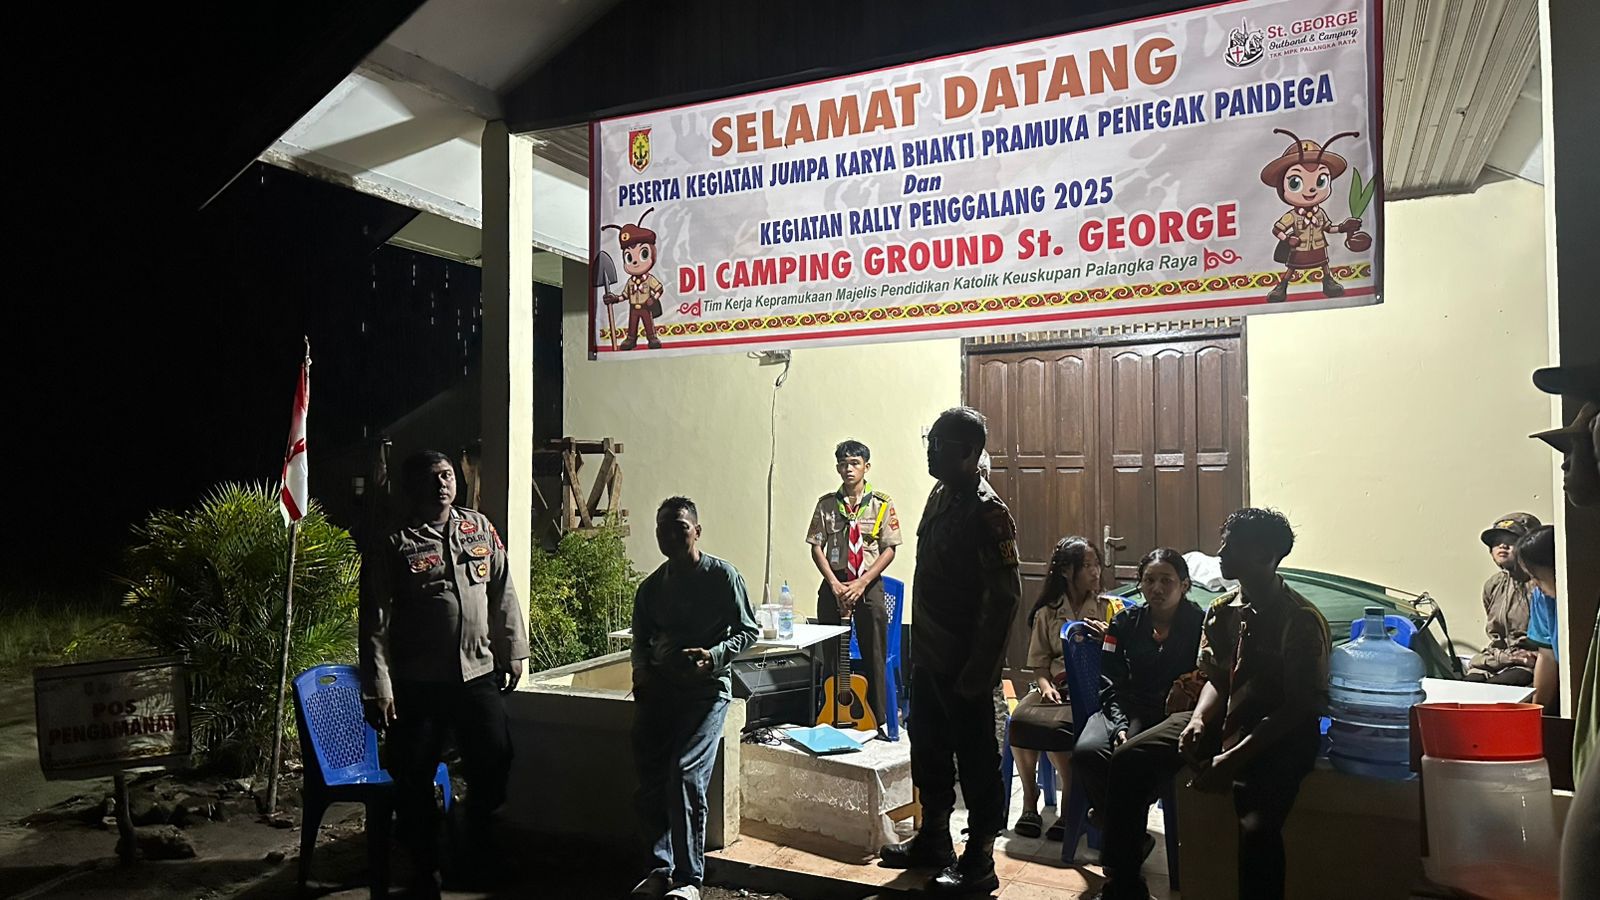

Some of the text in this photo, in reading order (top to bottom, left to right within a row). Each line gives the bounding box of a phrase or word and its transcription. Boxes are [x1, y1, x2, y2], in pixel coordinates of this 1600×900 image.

[1268, 11, 1358, 38] St. GEORGE
[1309, 33, 1315, 41] &
[1318, 28, 1358, 41] Camping
[1300, 43, 1336, 53] PALANGKA
[1338, 38, 1357, 47] RAYA
[711, 37, 1177, 157] SELAMAT DATANG
[618, 73, 1334, 207] PESERTA KEGIATAN JUMPA KARYA BHAKTI PRAMUKA PENEGAK PANDEGA
[904, 174, 941, 195] Dan
[760, 176, 1114, 246] KEGIATAN RALLY PENGGALANG 2025
[678, 203, 1237, 294] DI CAMPING GROUND St. GEORGE
[704, 253, 1197, 313] Tim Kerja Kepramukaan Majelis Pendidikan Katolik Keuskupan Palangka Raya
[461, 534, 486, 545] POLRI
[92, 699, 137, 718] POS
[48, 714, 179, 746] PENGAMANAN
